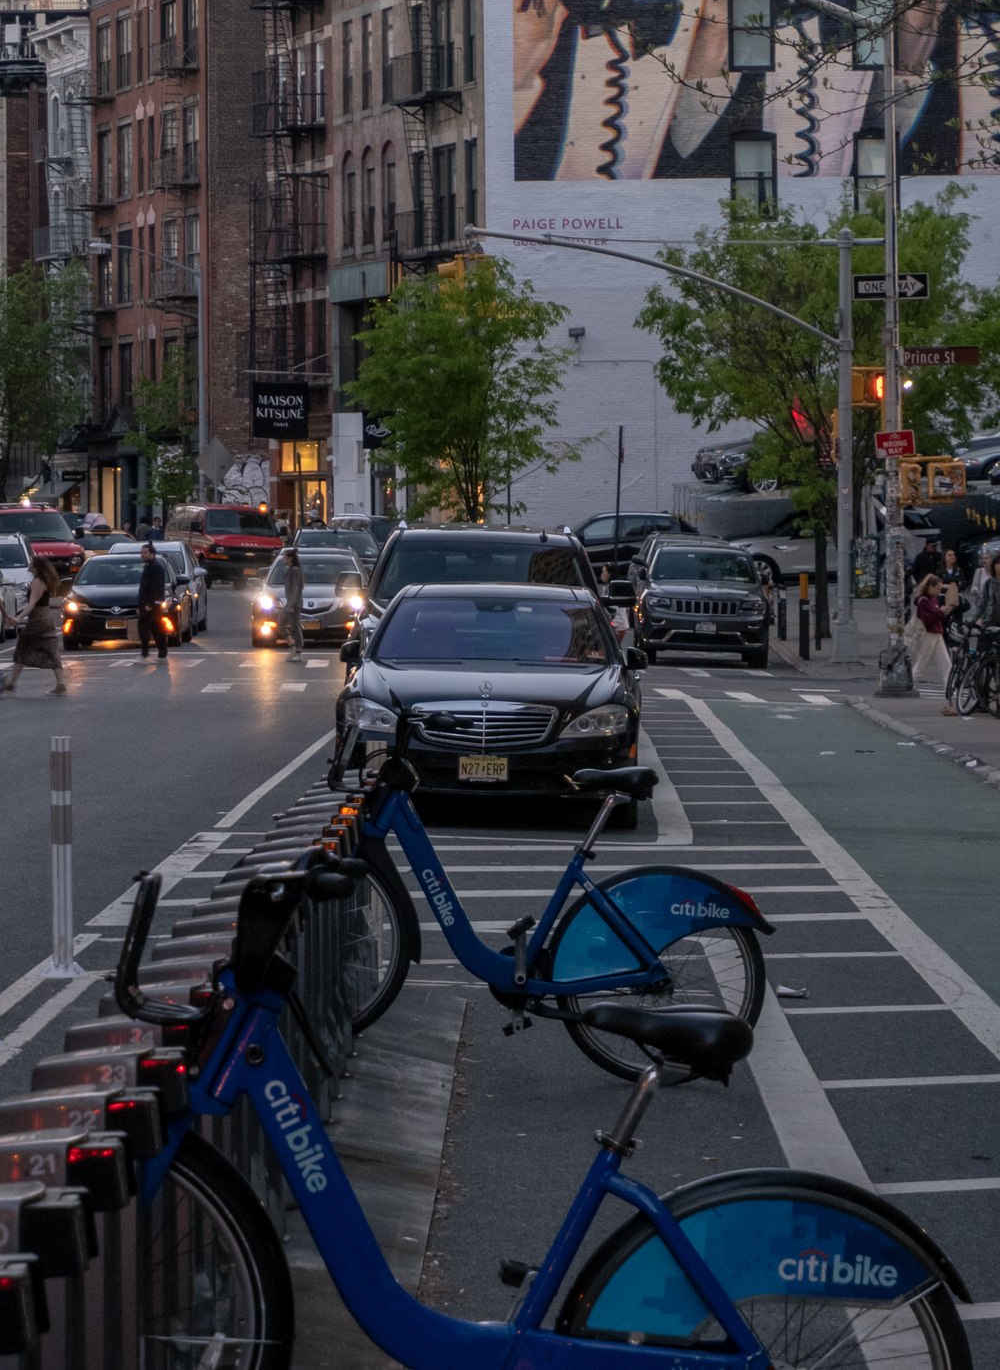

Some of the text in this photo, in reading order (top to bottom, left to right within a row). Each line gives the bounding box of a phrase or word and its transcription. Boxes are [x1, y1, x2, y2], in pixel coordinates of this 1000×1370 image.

[513, 218, 623, 230] PAIGE POWELL
[864, 282, 885, 291] ONE
[904, 351, 955, 364] Prince St
[258, 395, 303, 406] MAISON
[256, 406, 304, 419] KITSUNÉ
[883, 440, 908, 448] WRONG
[101, 1065, 126, 1083] 23
[70, 1111, 96, 1129] 22
[29, 1153, 56, 1176] 21
